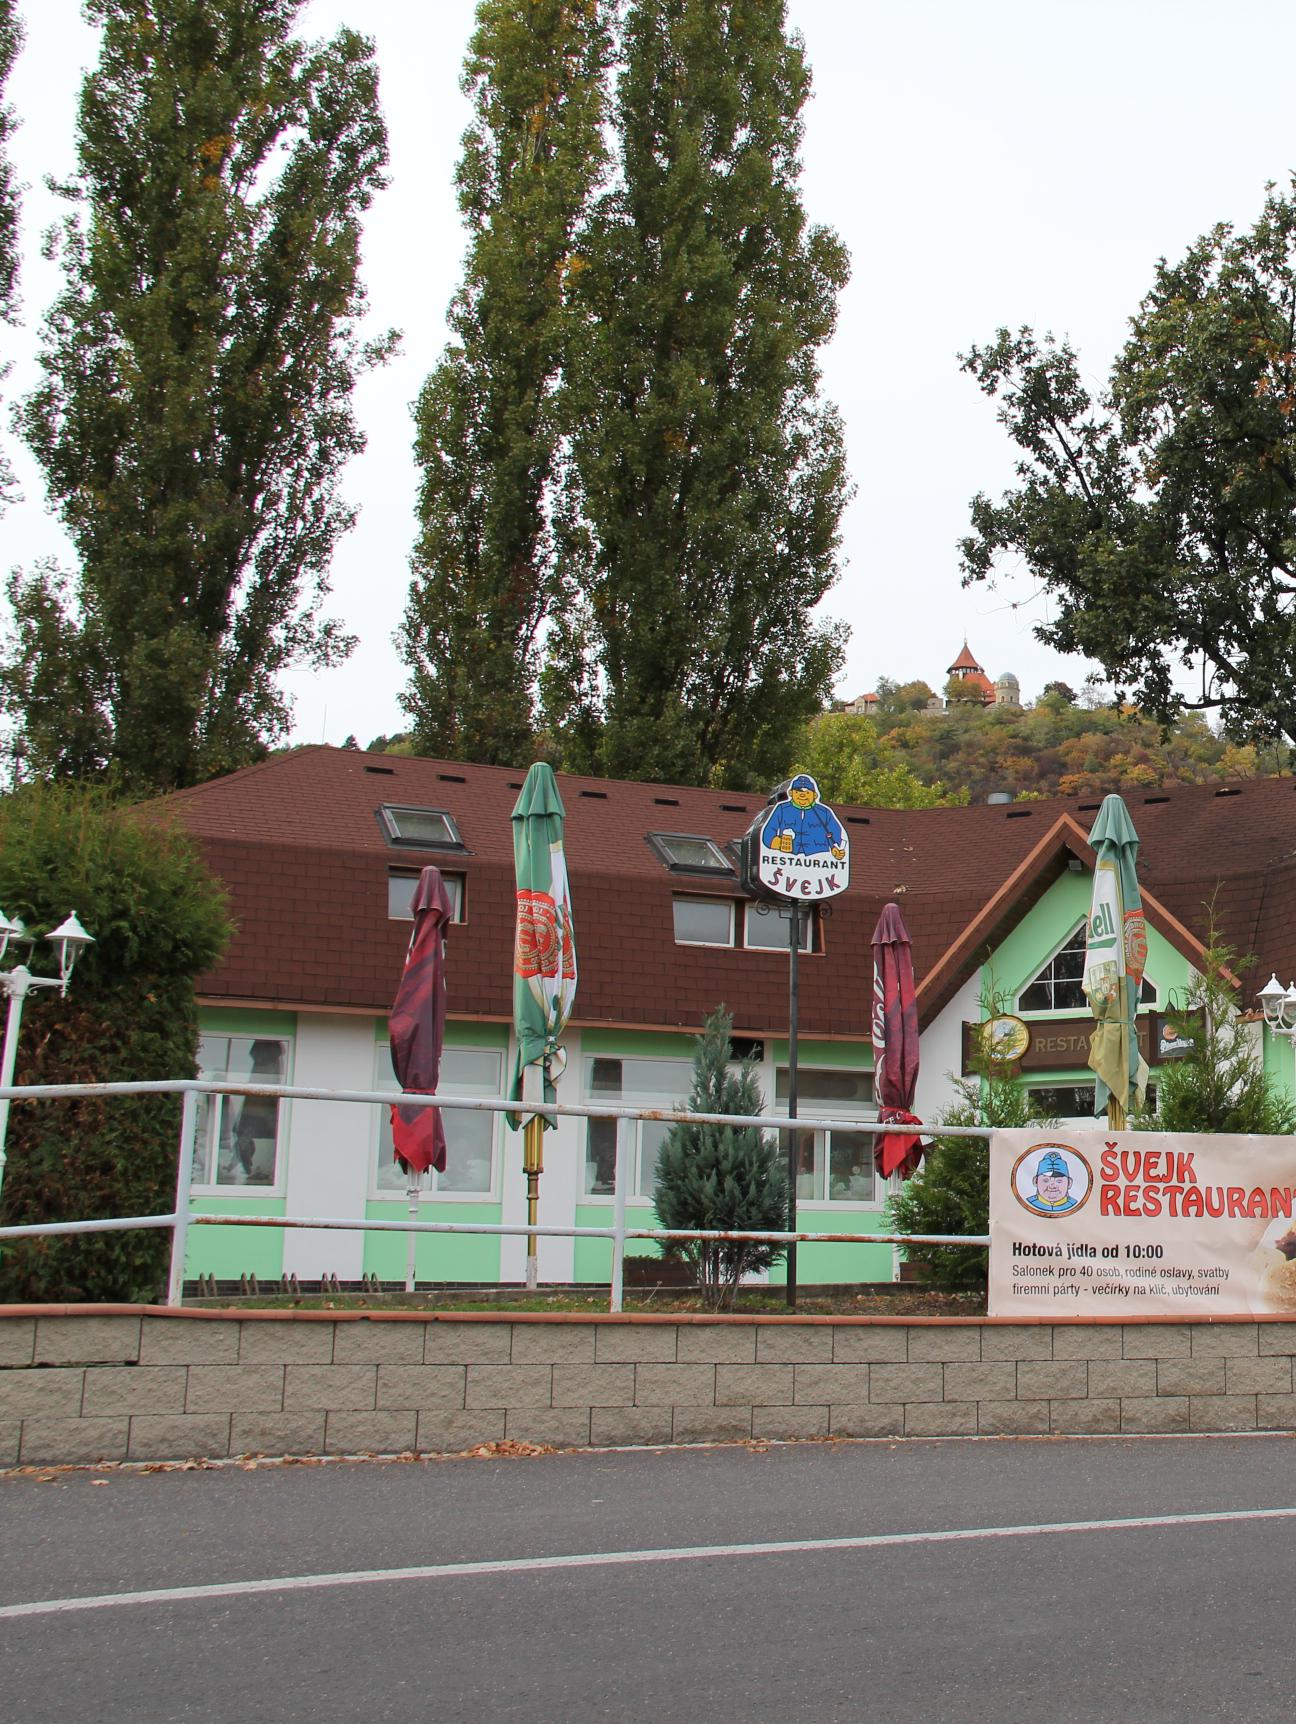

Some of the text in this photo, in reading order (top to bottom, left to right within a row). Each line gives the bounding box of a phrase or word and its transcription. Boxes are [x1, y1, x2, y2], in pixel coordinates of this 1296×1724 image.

[762, 855, 847, 870] RESTAURANT
[768, 867, 841, 896] ŠVEJK
[1100, 1141, 1198, 1184] ŠVEJK
[1012, 1242, 1163, 1260] Hotová jídla od 10:00
[1012, 1264, 1230, 1281] Salonek pro 40 osob, rodiné oslavy, svatby
[1012, 1282, 1050, 1295] firemní
[1053, 1284, 1080, 1297] párty
[1092, 1283, 1130, 1298] večírky
[1133, 1286, 1146, 1295] na
[1172, 1284, 1220, 1298] ubytování
